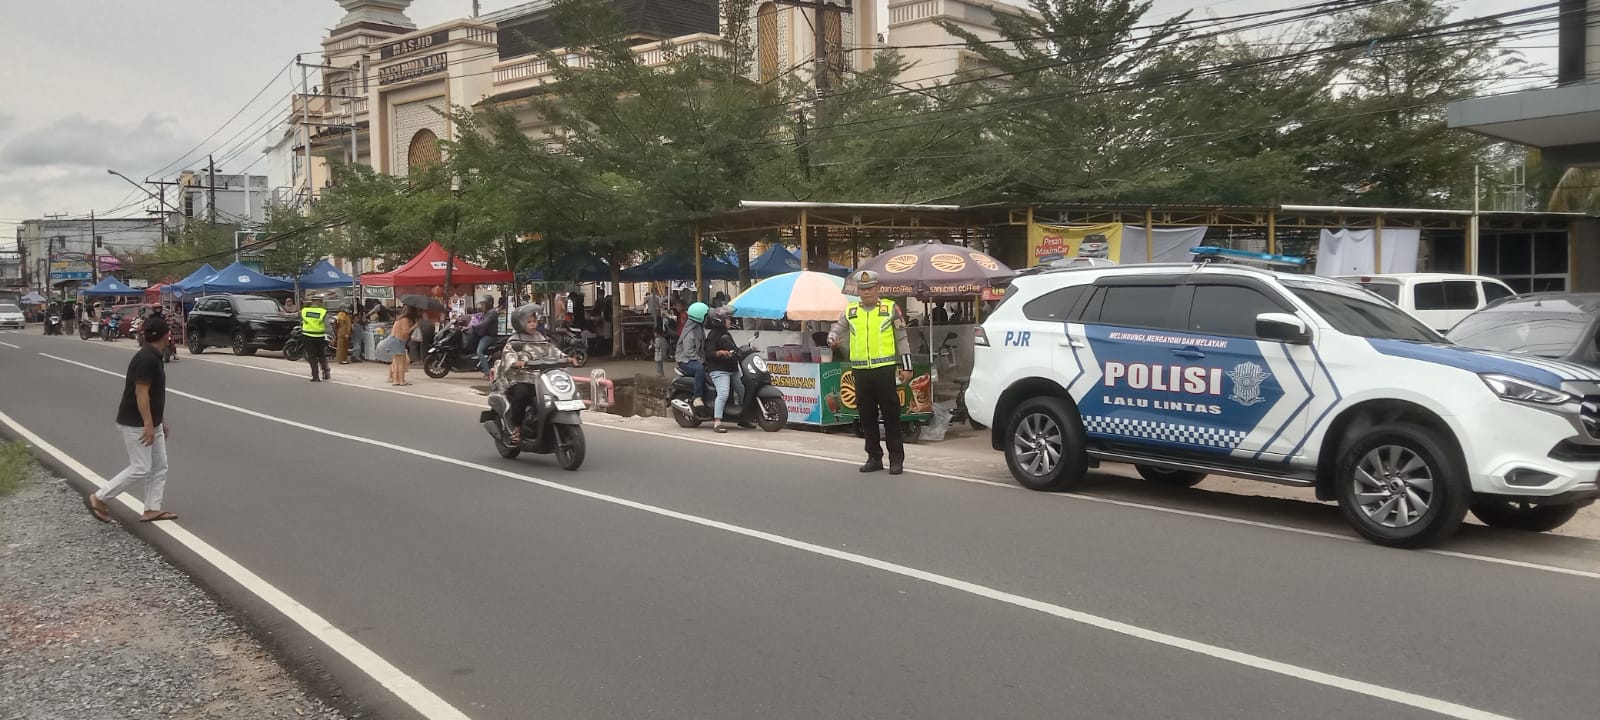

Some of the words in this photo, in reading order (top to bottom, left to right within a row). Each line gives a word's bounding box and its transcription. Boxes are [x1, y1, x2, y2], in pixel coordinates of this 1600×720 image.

[392, 35, 432, 56] MASJID
[1043, 237, 1062, 246] Pesan
[1035, 245, 1069, 256] MaximCar
[892, 284, 912, 293] coffee
[929, 285, 957, 293] sanubari
[958, 283, 981, 292] coffee
[1005, 331, 1031, 347] PJR
[1181, 337, 1195, 345] DAN
[1104, 361, 1222, 395] POLISI
[1103, 395, 1148, 408] LALU
[1154, 397, 1222, 415] LINTAS
